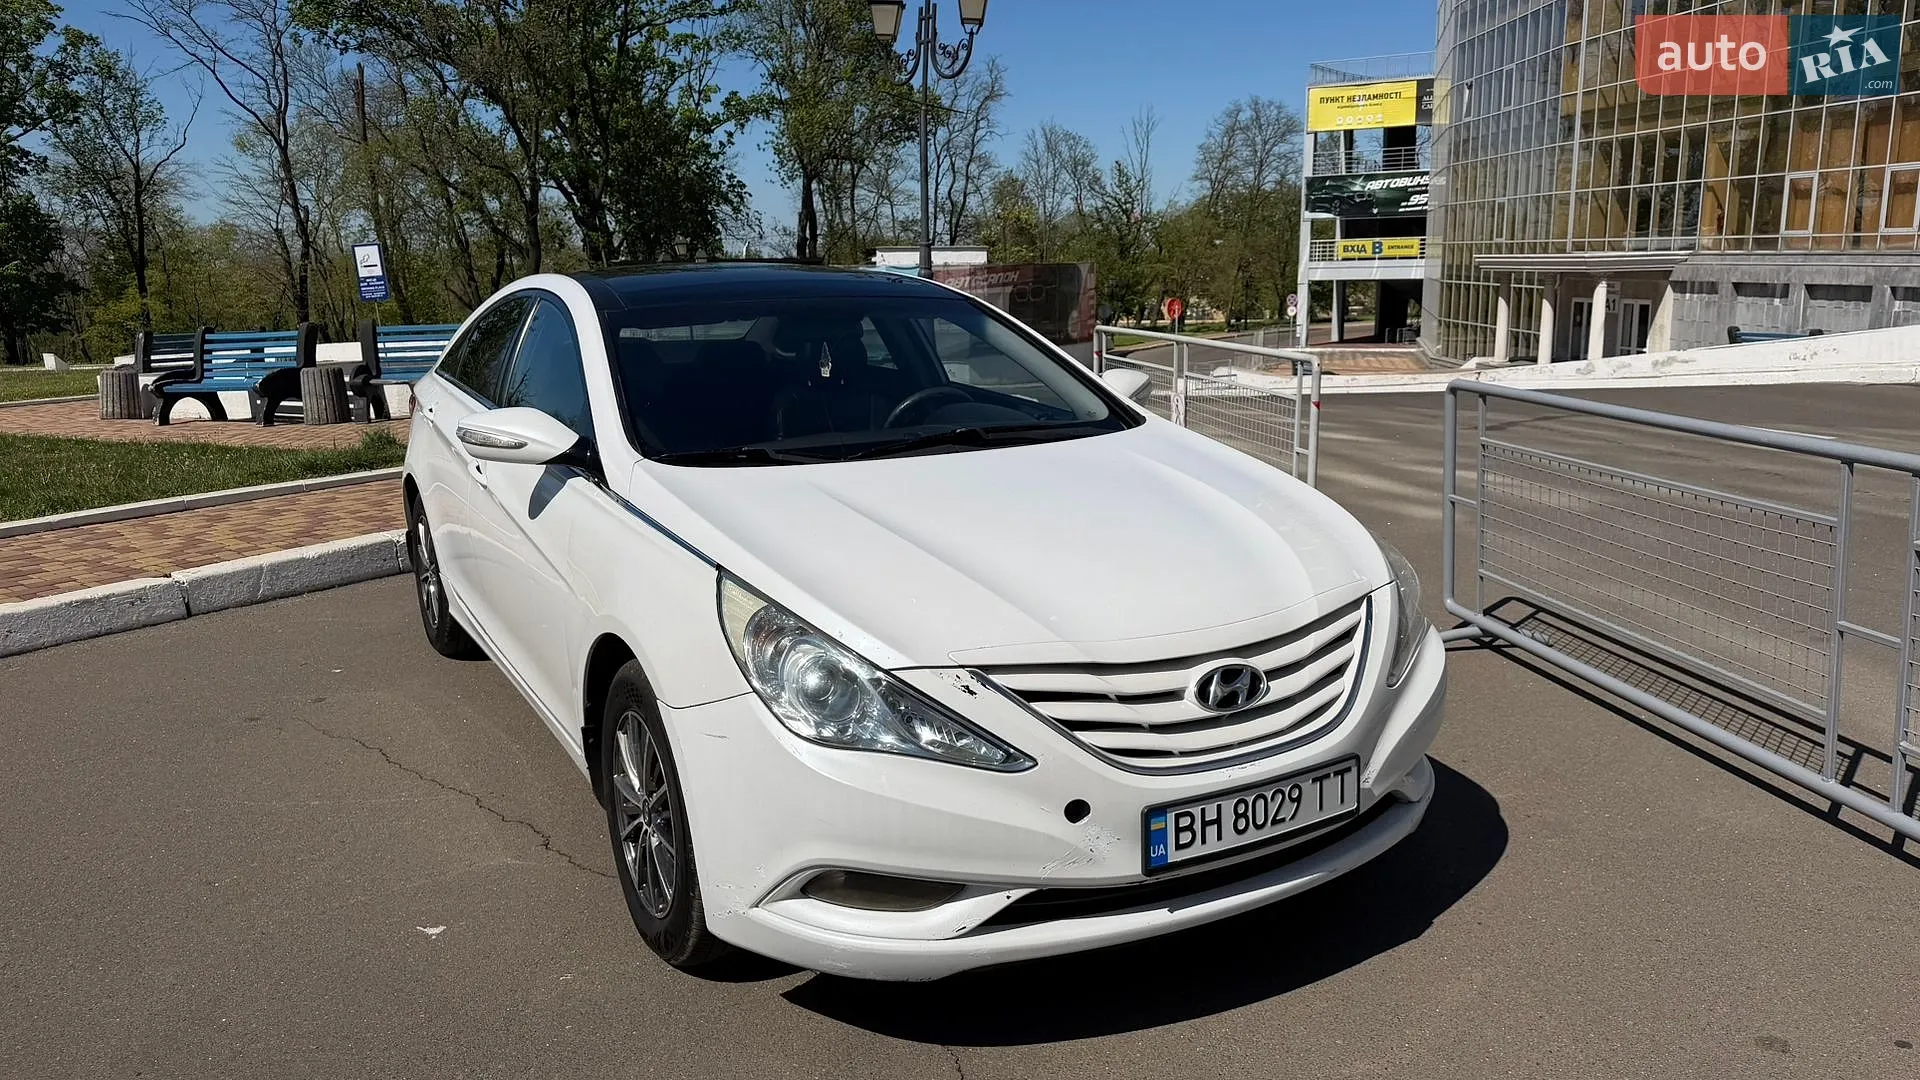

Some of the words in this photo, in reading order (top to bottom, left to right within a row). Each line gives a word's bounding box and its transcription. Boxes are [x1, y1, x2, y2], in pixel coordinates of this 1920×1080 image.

[1319, 95, 1345, 104] ПУНКТ
[1347, 91, 1402, 103] НЕЗЛАМНОСТІ
[1343, 244, 1367, 254] ВХІД
[1174, 803, 1223, 851] BH
[1232, 783, 1303, 836] 8029
[1309, 766, 1352, 811] TT
[1150, 843, 1166, 857] UA
